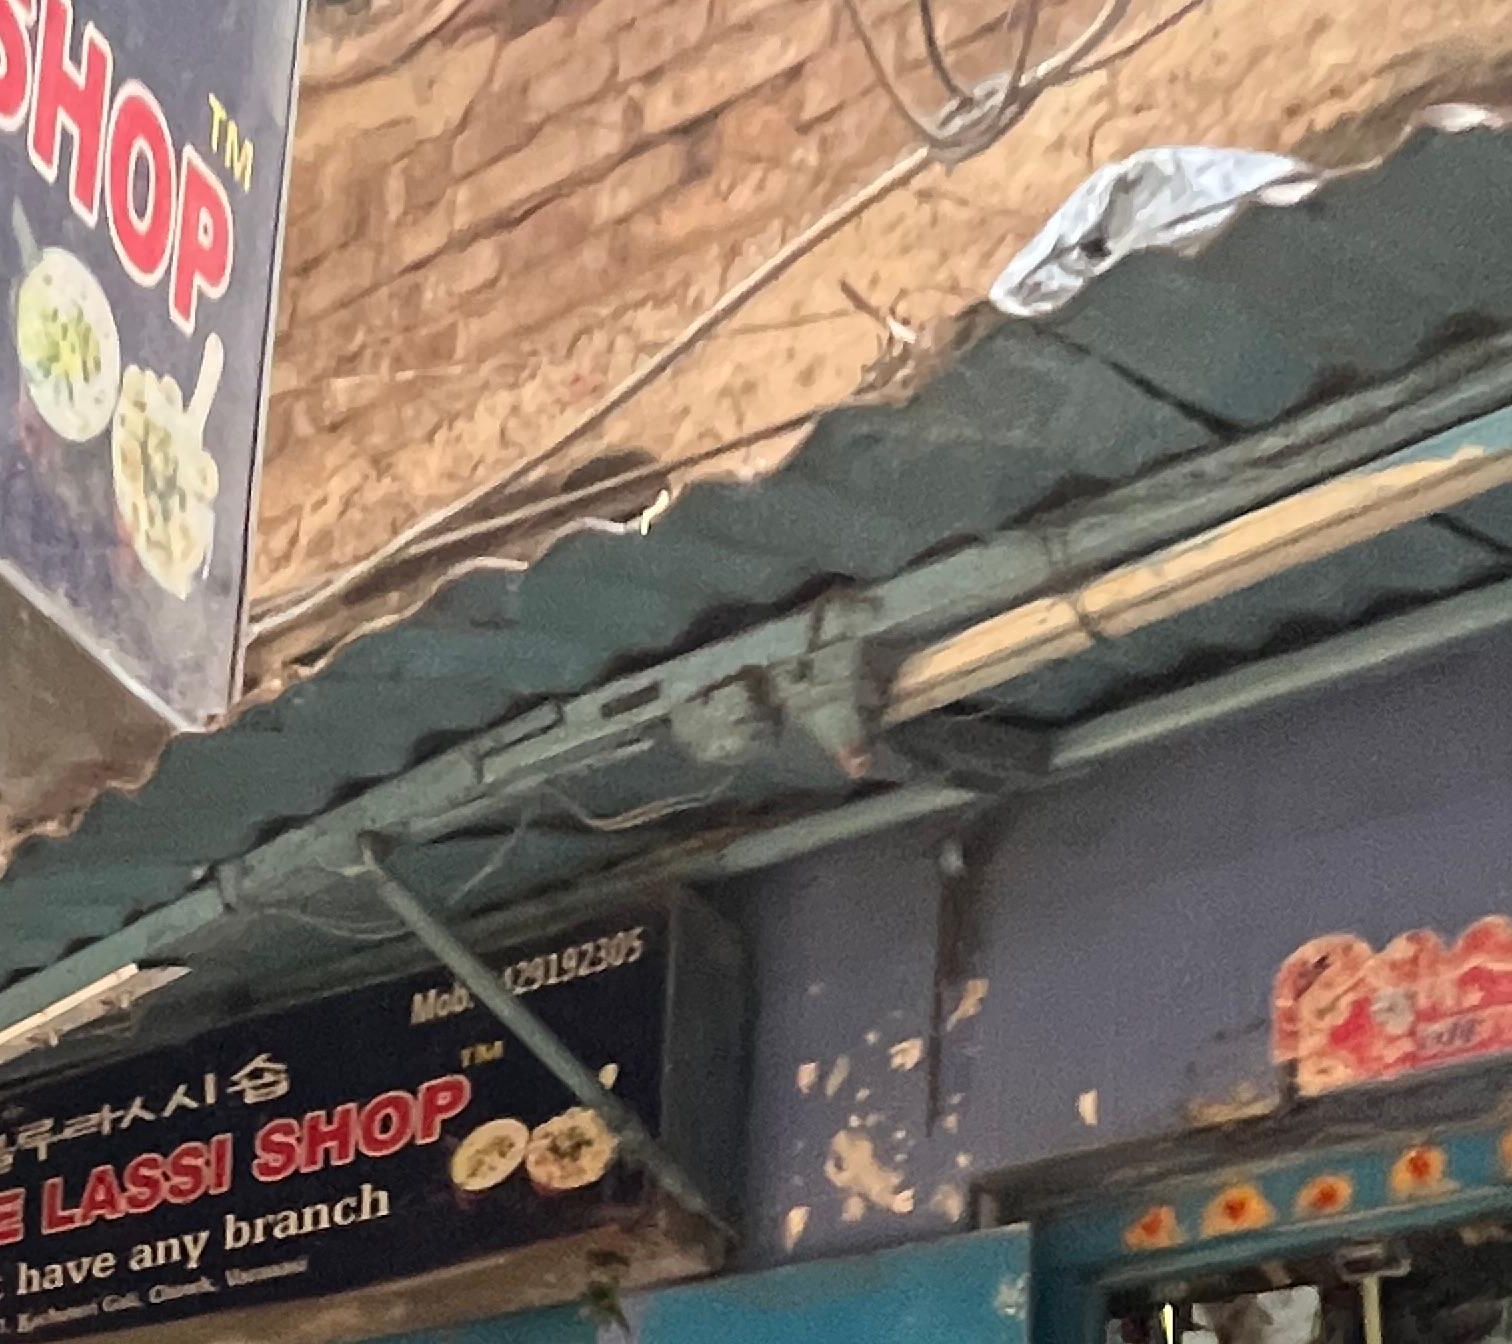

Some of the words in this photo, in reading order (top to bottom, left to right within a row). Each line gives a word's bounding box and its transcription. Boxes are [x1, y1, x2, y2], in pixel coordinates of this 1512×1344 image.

[208, 92, 254, 193] TM
[41, 1132, 234, 1236] LASSI
[252, 1074, 471, 1183] SHOP
[16, 1252, 117, 1296] have
[128, 1230, 210, 1269] any
[224, 1182, 391, 1250] branch
